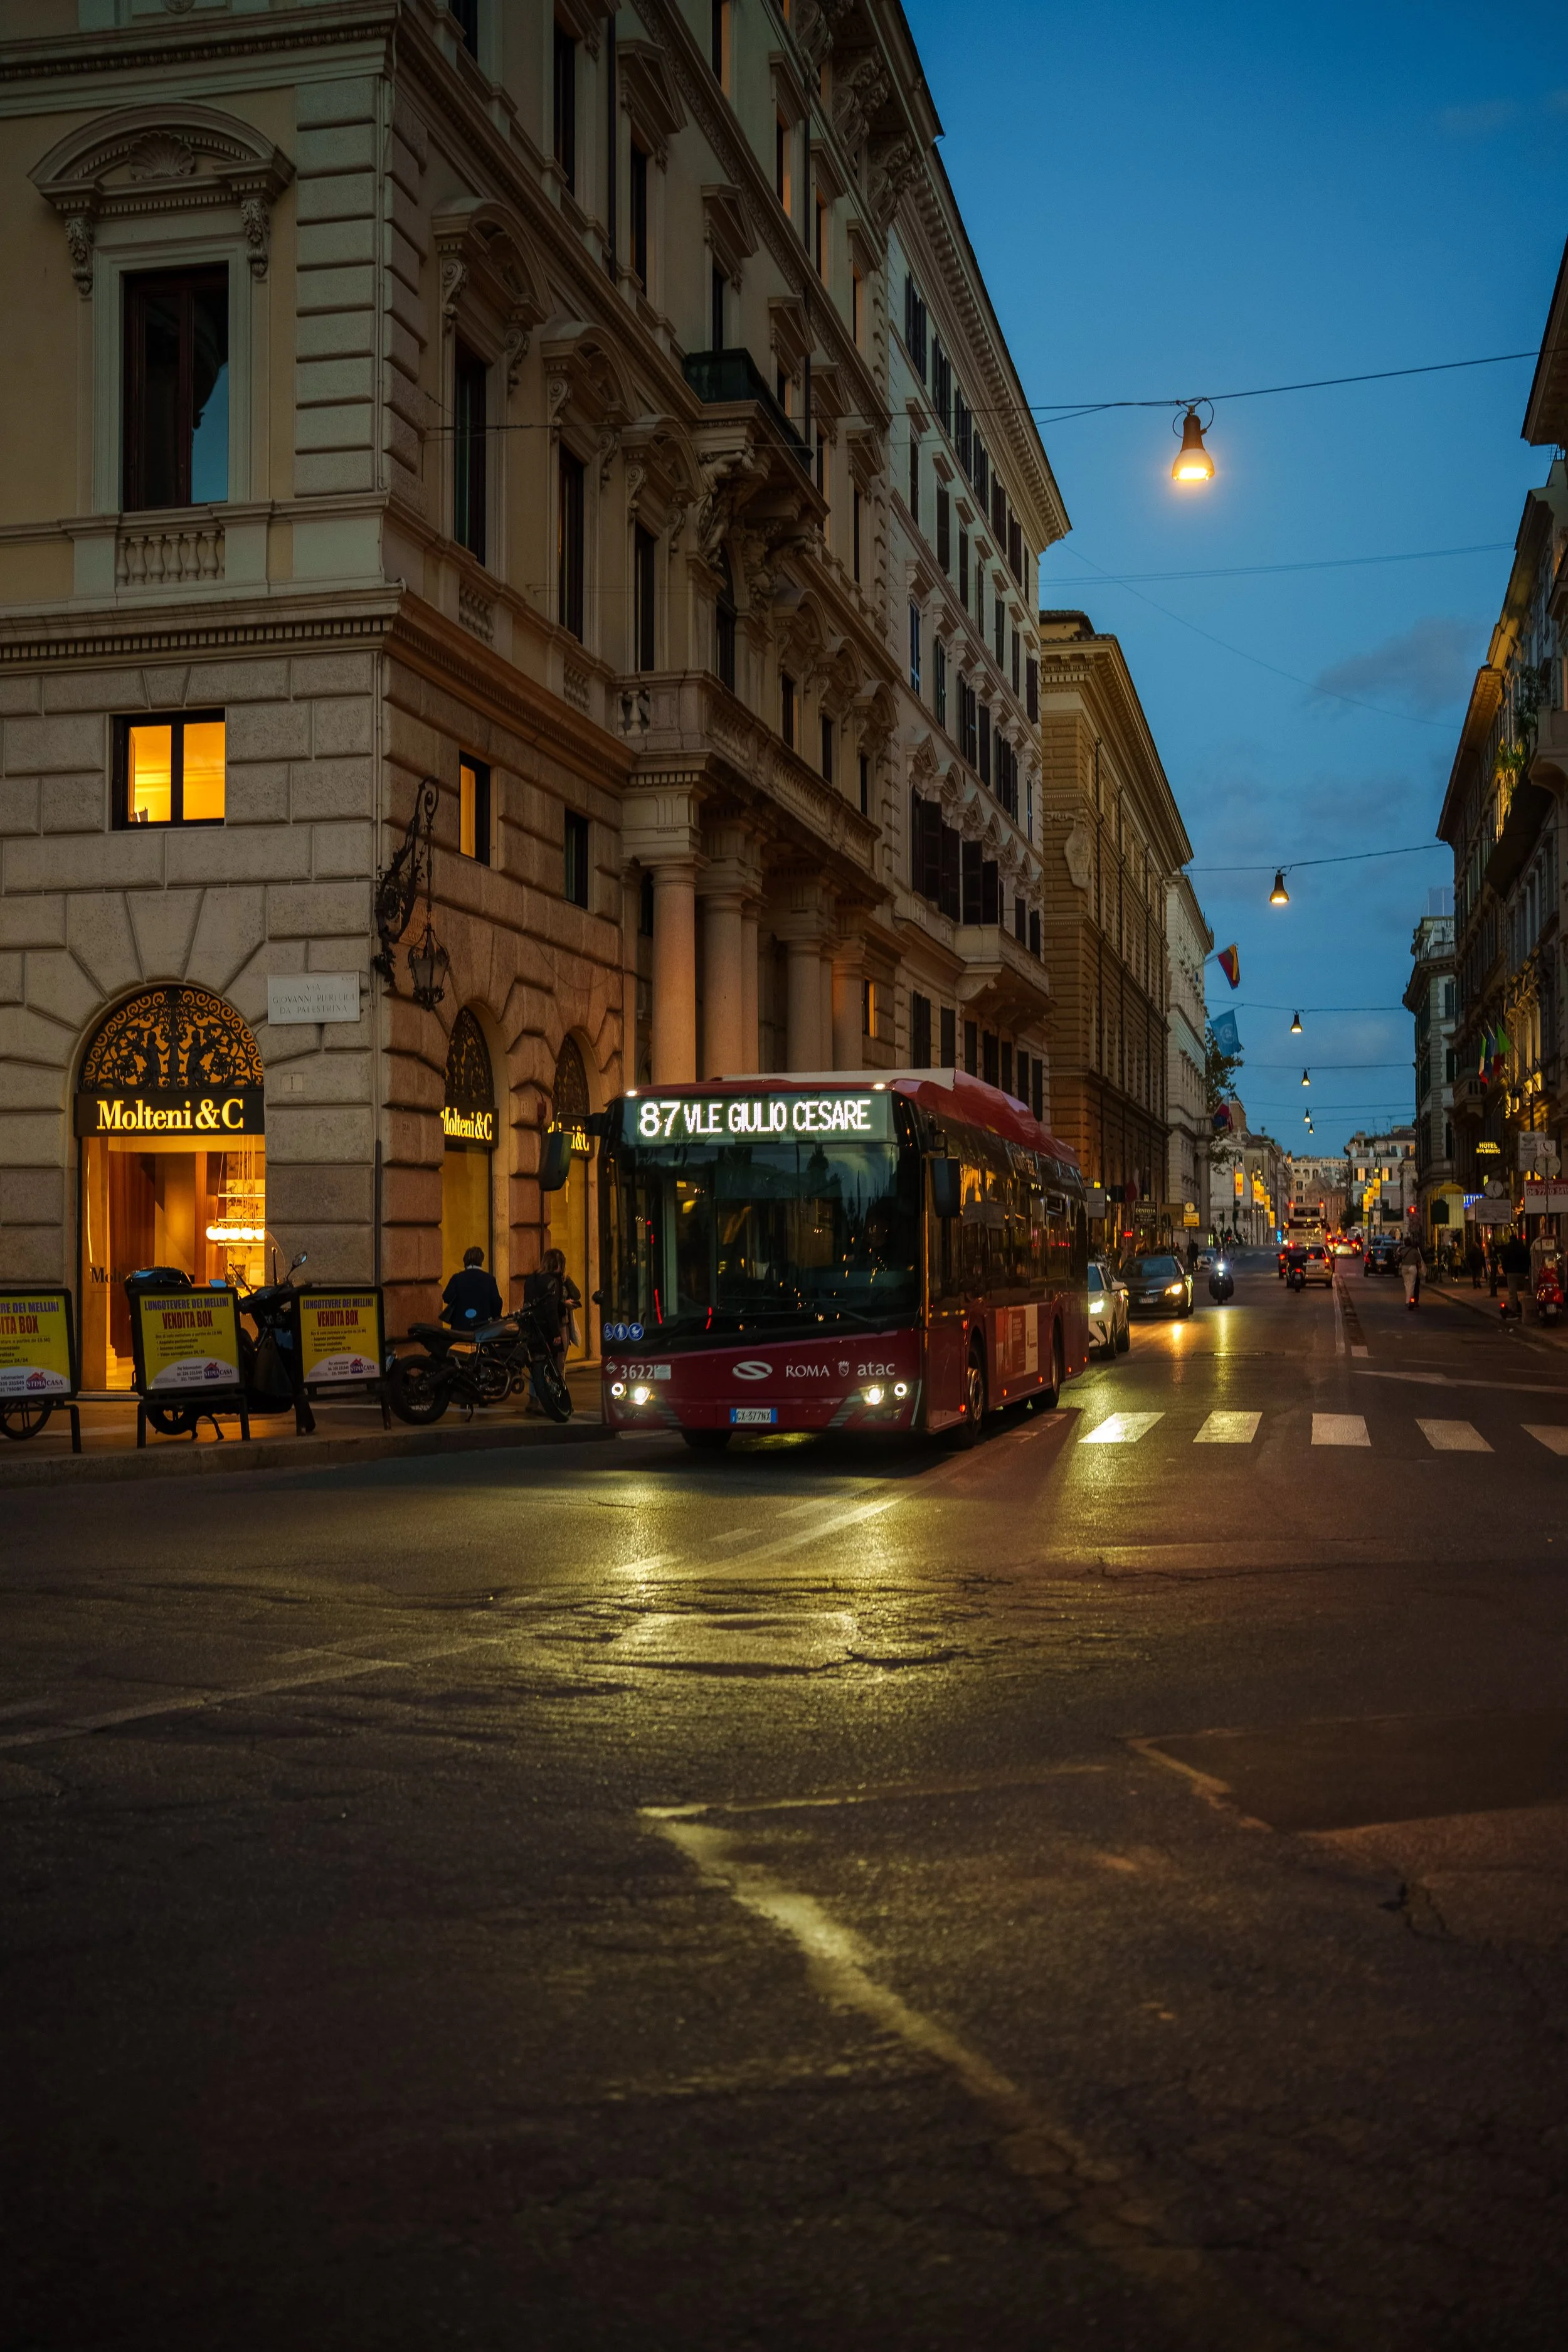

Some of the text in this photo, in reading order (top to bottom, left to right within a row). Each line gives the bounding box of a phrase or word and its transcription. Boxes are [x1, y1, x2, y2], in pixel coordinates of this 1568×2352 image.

[273, 994, 312, 1004] GIOVANNI
[297, 1004, 347, 1014] PALESTRINA
[639, 1099, 871, 1136] 87 VLE GIULIO CESARE
[13, 1303, 26, 1313] DEI
[28, 1301, 59, 1312] MELLINI
[144, 1297, 229, 1311] LUNGOTEVERE DEI MELLINI
[304, 1298, 373, 1310] LUNGOTEVERE DEI MELLINI
[19, 1315, 39, 1333] BOX
[162, 1310, 213, 1330] VENDITA BOX
[317, 1310, 358, 1327] VENDITA BOX
[621, 1365, 654, 1379] 3622
[786, 1365, 830, 1377] ROMA
[857, 1361, 895, 1376] atac
